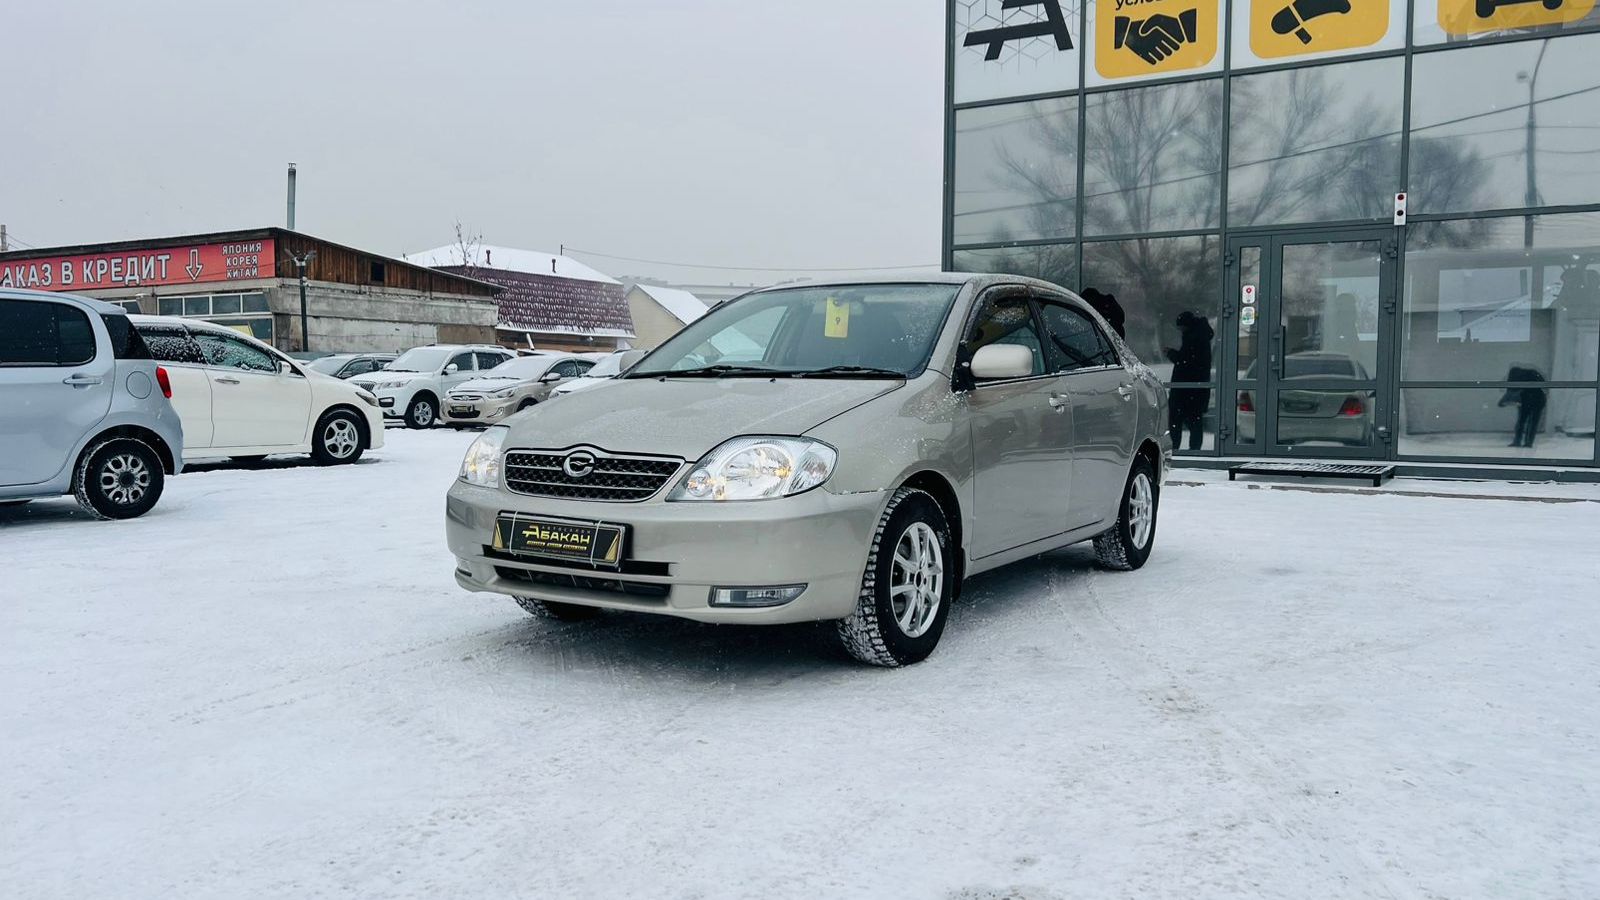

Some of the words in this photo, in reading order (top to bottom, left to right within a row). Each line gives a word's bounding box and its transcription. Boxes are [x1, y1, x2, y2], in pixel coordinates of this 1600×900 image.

[222, 242, 262, 255] ЯПОНИЯ
[226, 255, 258, 267] КОРЕЯ
[2, 263, 52, 288] АКАЗ
[61, 261, 74, 284] В
[83, 254, 170, 285] КРЕДИТ
[226, 266, 258, 279] КИТАЙ
